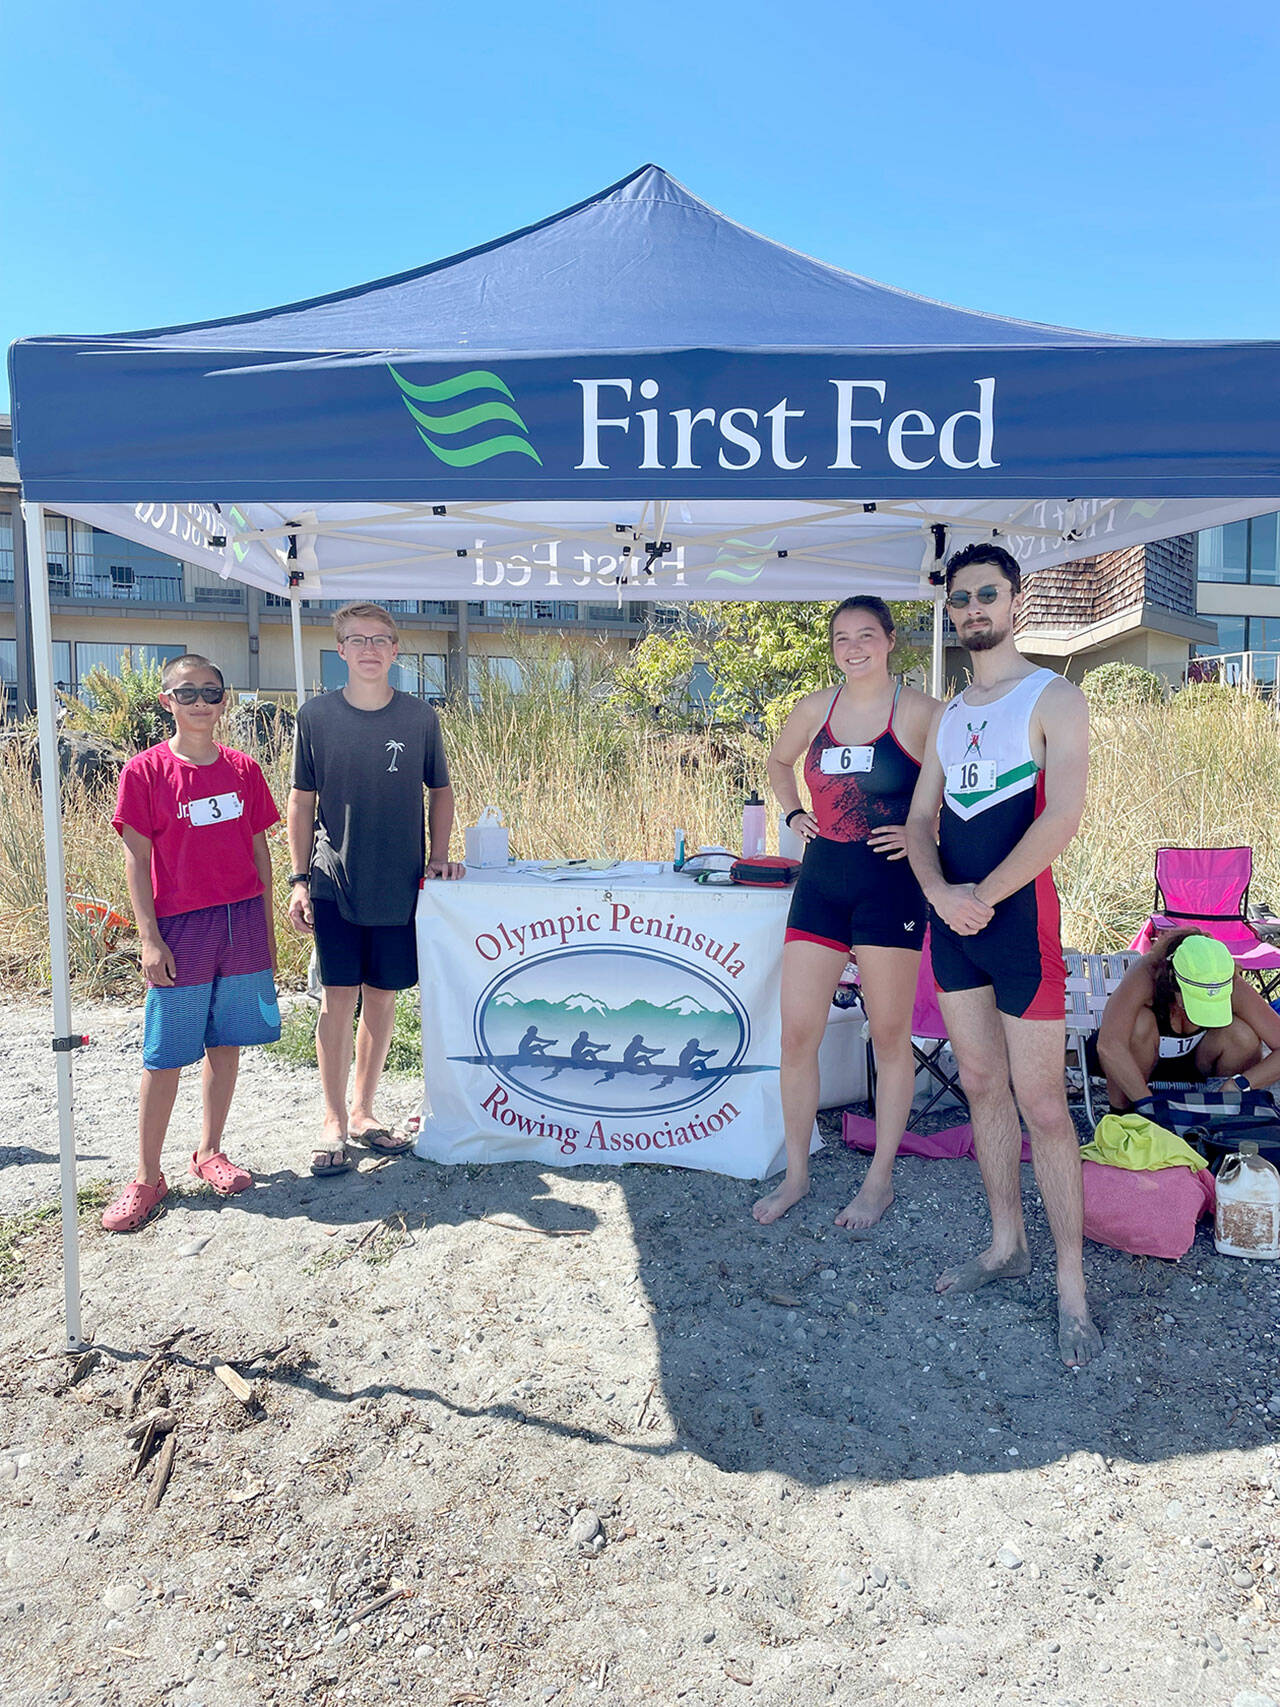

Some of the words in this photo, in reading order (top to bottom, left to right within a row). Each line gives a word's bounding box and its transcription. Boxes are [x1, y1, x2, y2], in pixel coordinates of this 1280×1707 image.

[573, 377, 808, 471] First
[827, 377, 1001, 471] Fed
[841, 748, 852, 770] 6
[960, 763, 979, 789] 16
[208, 798, 222, 819] 3
[475, 906, 600, 961] Olympic
[609, 903, 746, 979] Peninsula
[1177, 1037, 1194, 1055] 17
[480, 1083, 580, 1155] Rowing
[584, 1101, 741, 1151] Association
